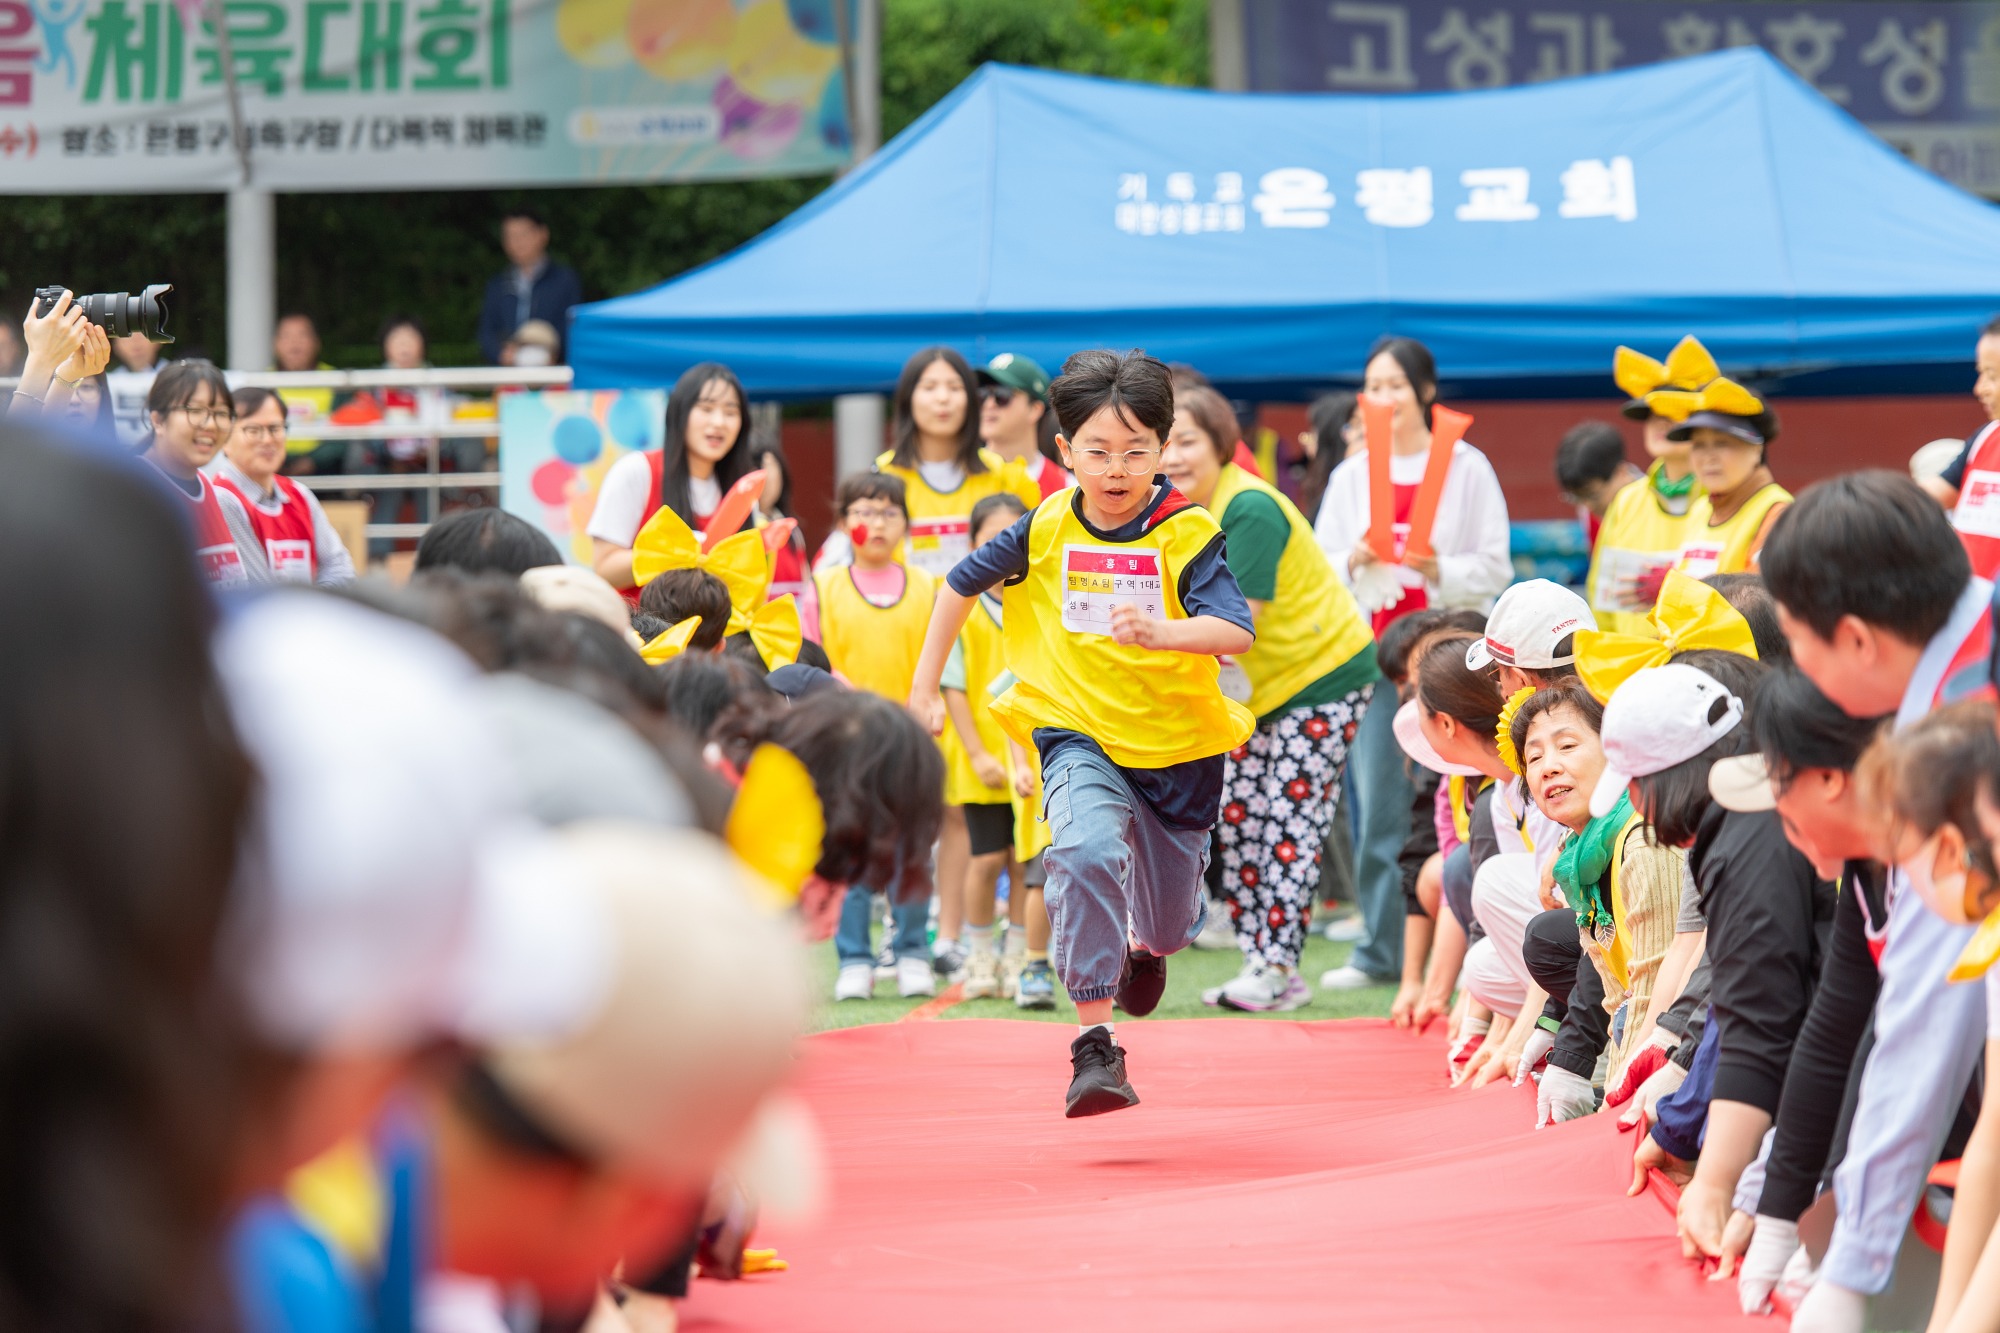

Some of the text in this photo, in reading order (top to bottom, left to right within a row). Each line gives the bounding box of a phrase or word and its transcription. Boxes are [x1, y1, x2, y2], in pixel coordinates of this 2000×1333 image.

[83, 0, 510, 101] 체육대회
[1326, 2, 1624, 90] 고성과
[1253, 156, 1638, 229] 은평교회
